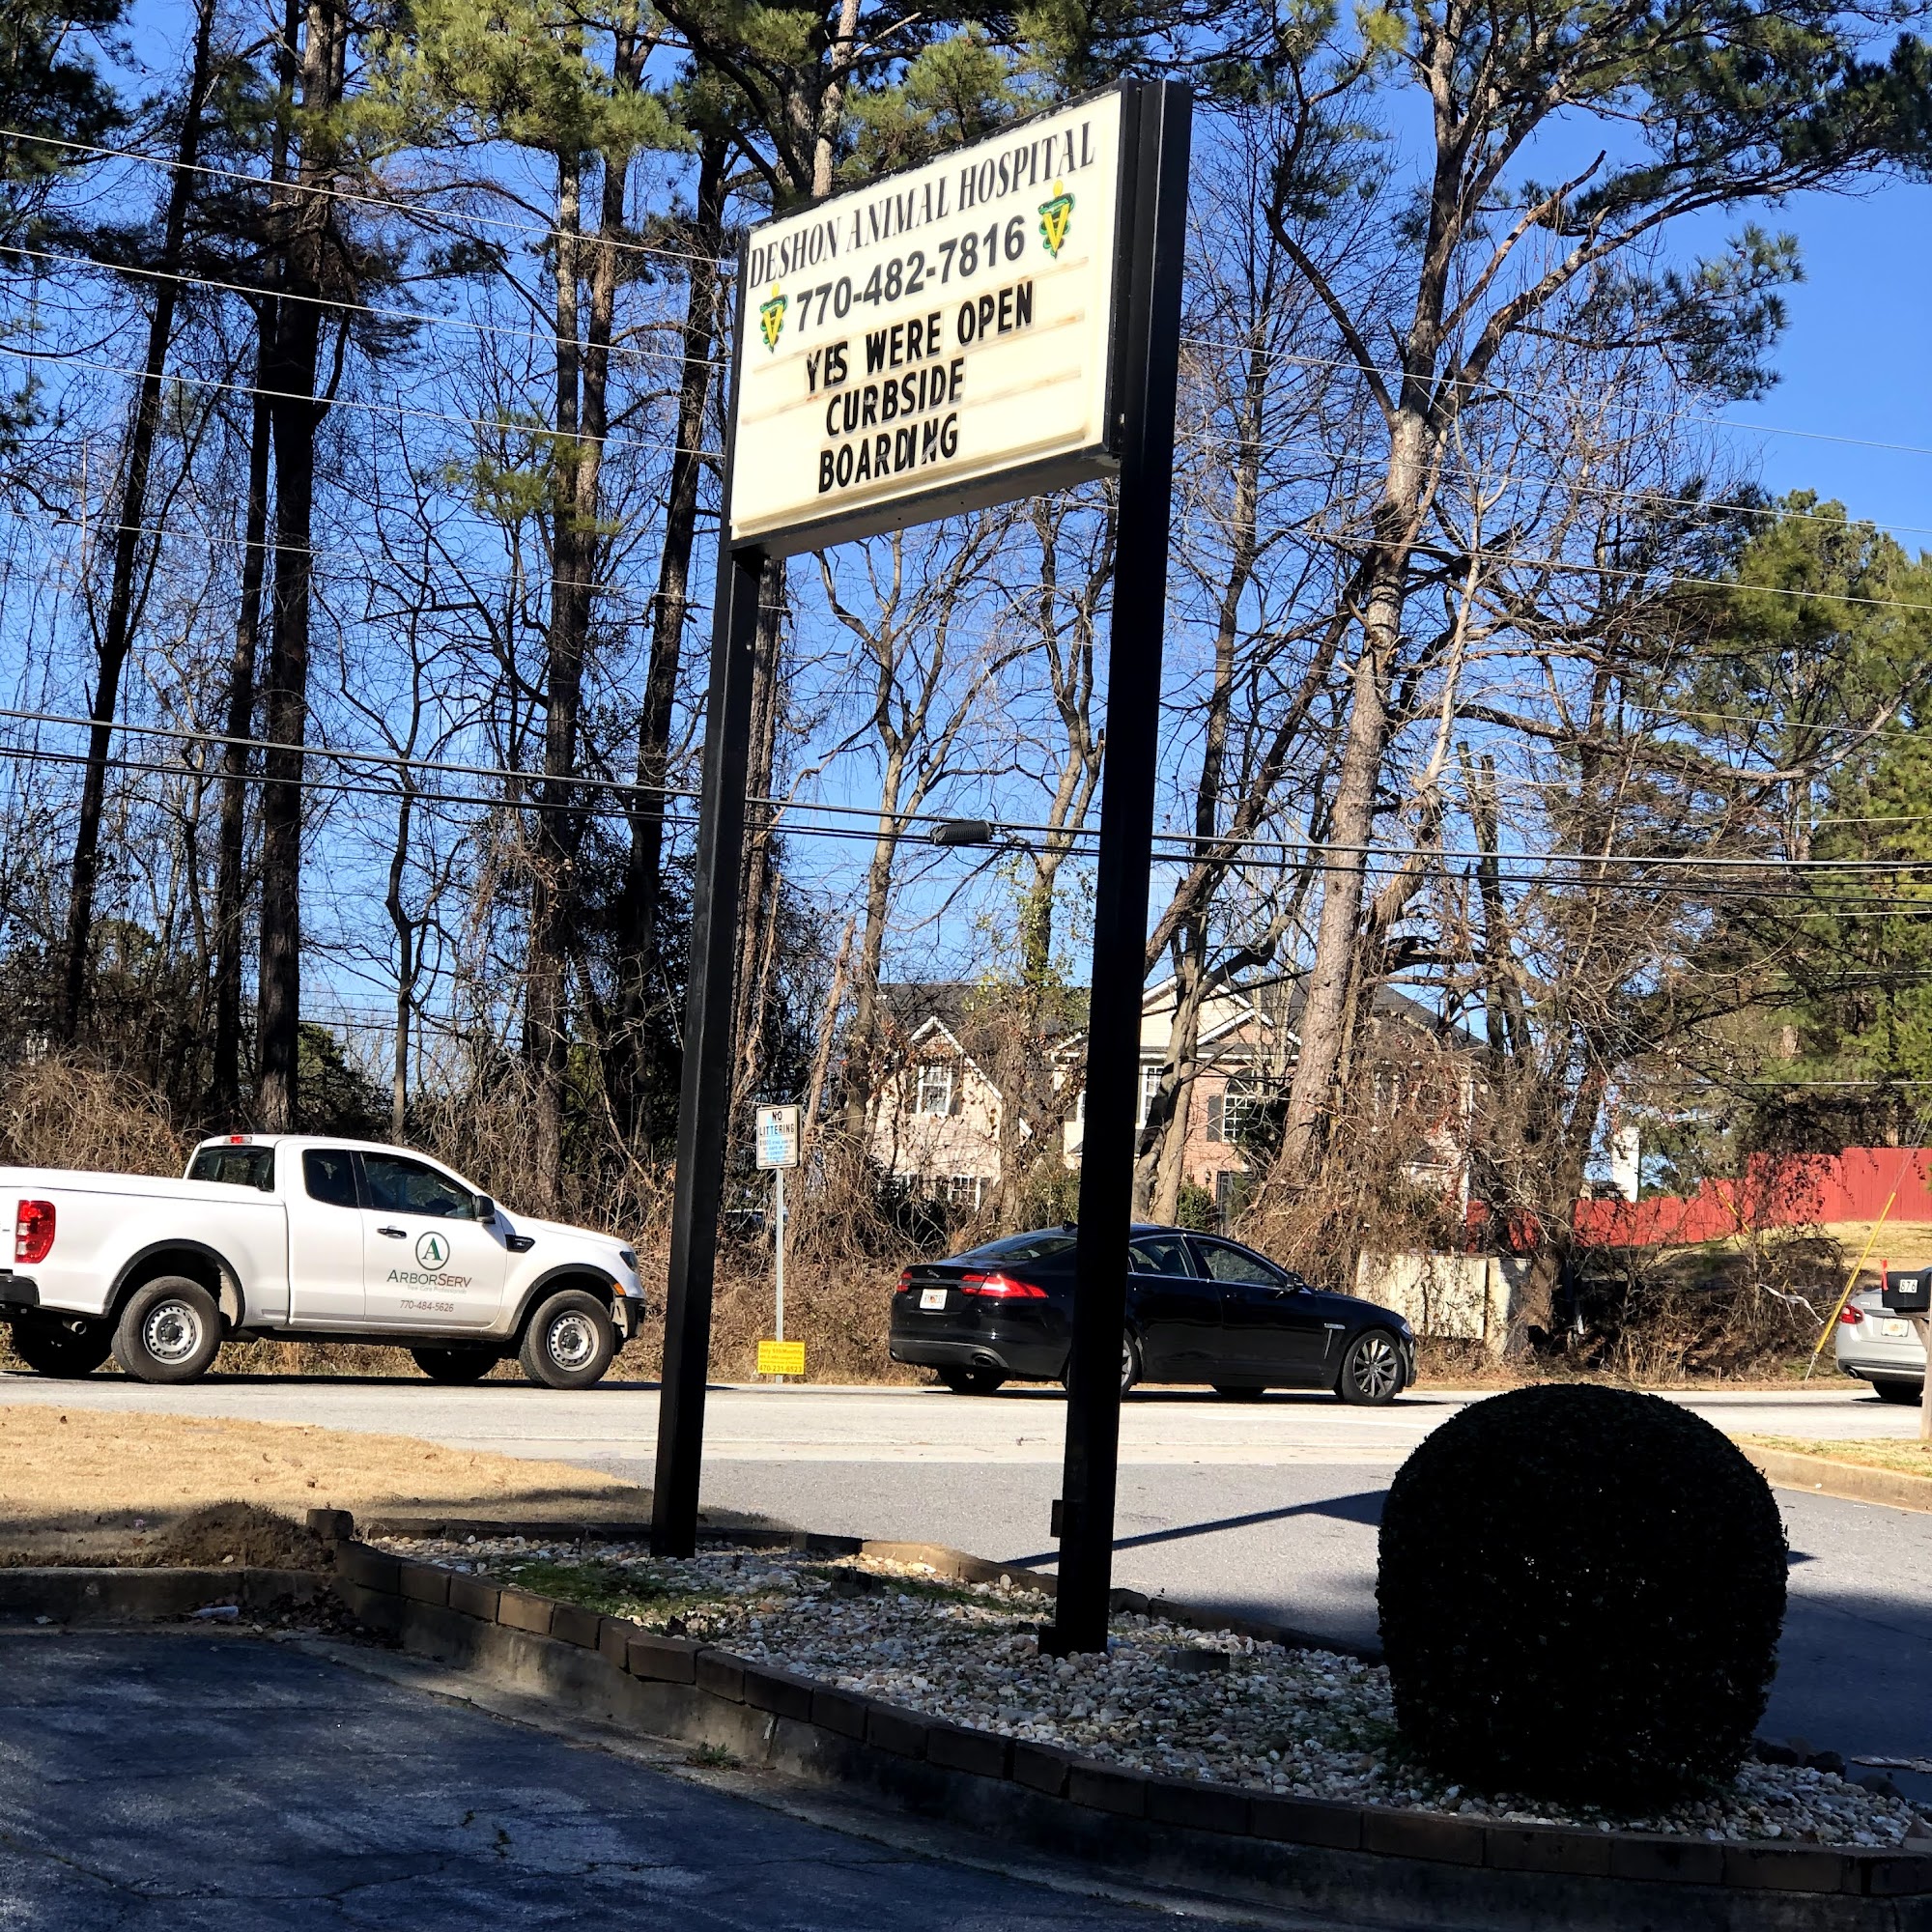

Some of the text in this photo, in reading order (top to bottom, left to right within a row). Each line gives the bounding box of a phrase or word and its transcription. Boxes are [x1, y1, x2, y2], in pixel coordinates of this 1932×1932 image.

[750, 122, 1095, 289] DESHON ANIMAL HOSPITAL
[796, 214, 1025, 332] 770-482-7816
[806, 280, 1033, 393] YES WERE OPEN
[826, 356, 964, 438] CURBSIDE
[818, 412, 957, 493] BOARDING
[758, 1123, 795, 1136] LITTERING
[772, 1110, 782, 1122] NO
[421, 1237, 443, 1261] A
[386, 1269, 472, 1288] ARBORSERV
[400, 1299, 454, 1313] 770-484-5626
